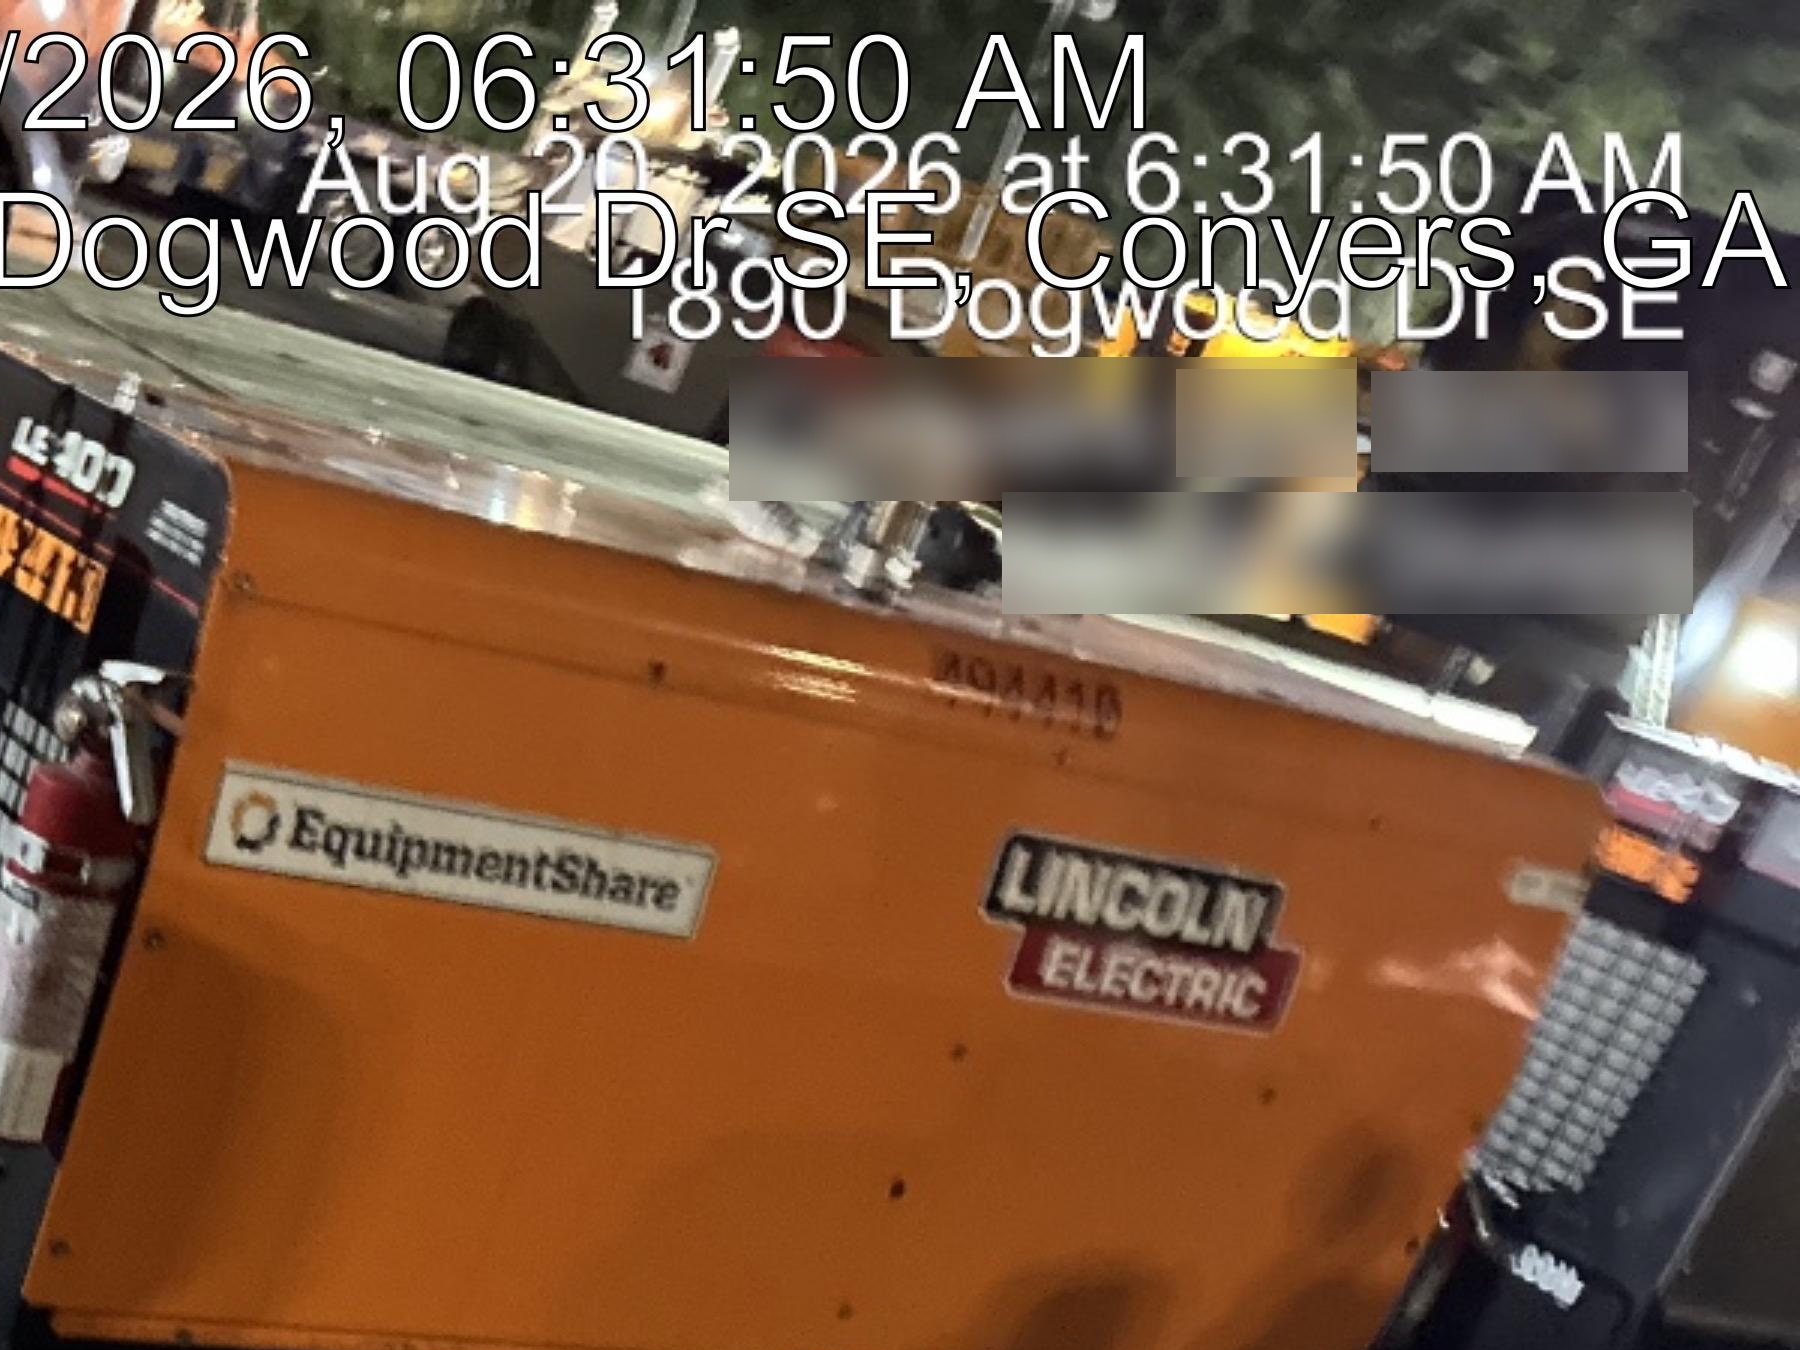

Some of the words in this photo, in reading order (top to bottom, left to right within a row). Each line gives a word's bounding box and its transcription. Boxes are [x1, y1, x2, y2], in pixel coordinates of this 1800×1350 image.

[286, 805, 682, 913] EquipmentShare
[999, 842, 1268, 953] LINCOLN
[1039, 933, 1268, 1018] ELECTRIC
